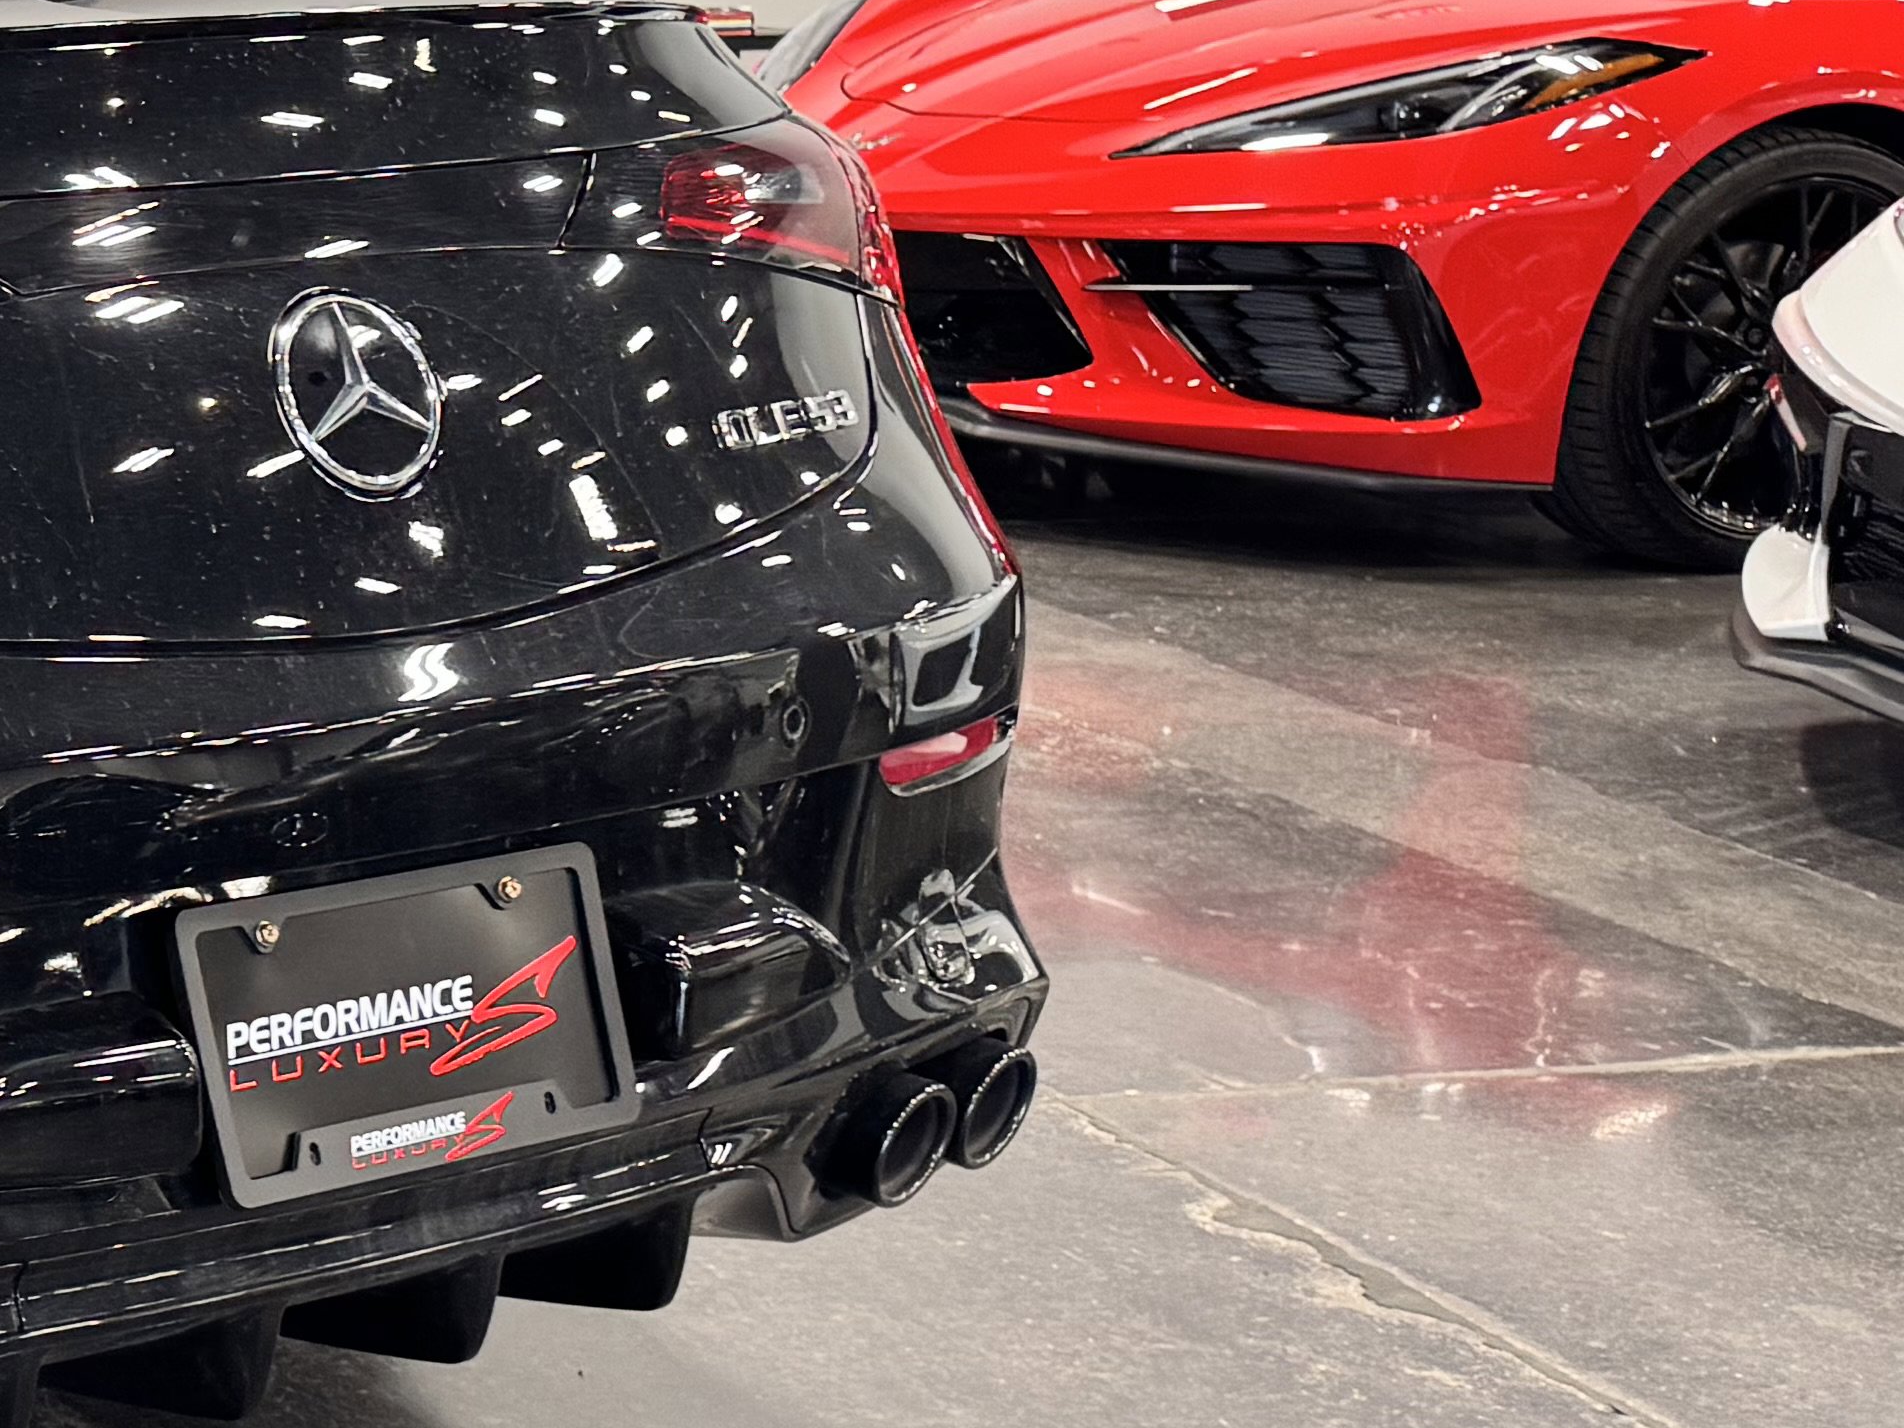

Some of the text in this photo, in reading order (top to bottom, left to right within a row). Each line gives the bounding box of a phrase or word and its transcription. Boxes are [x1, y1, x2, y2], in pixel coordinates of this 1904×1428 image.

[226, 974, 475, 1061] PERFORMANCE
[229, 1019, 472, 1093] LUXURY
[350, 1111, 467, 1155] PERFORMANCE
[351, 1133, 465, 1171] LUXURY
